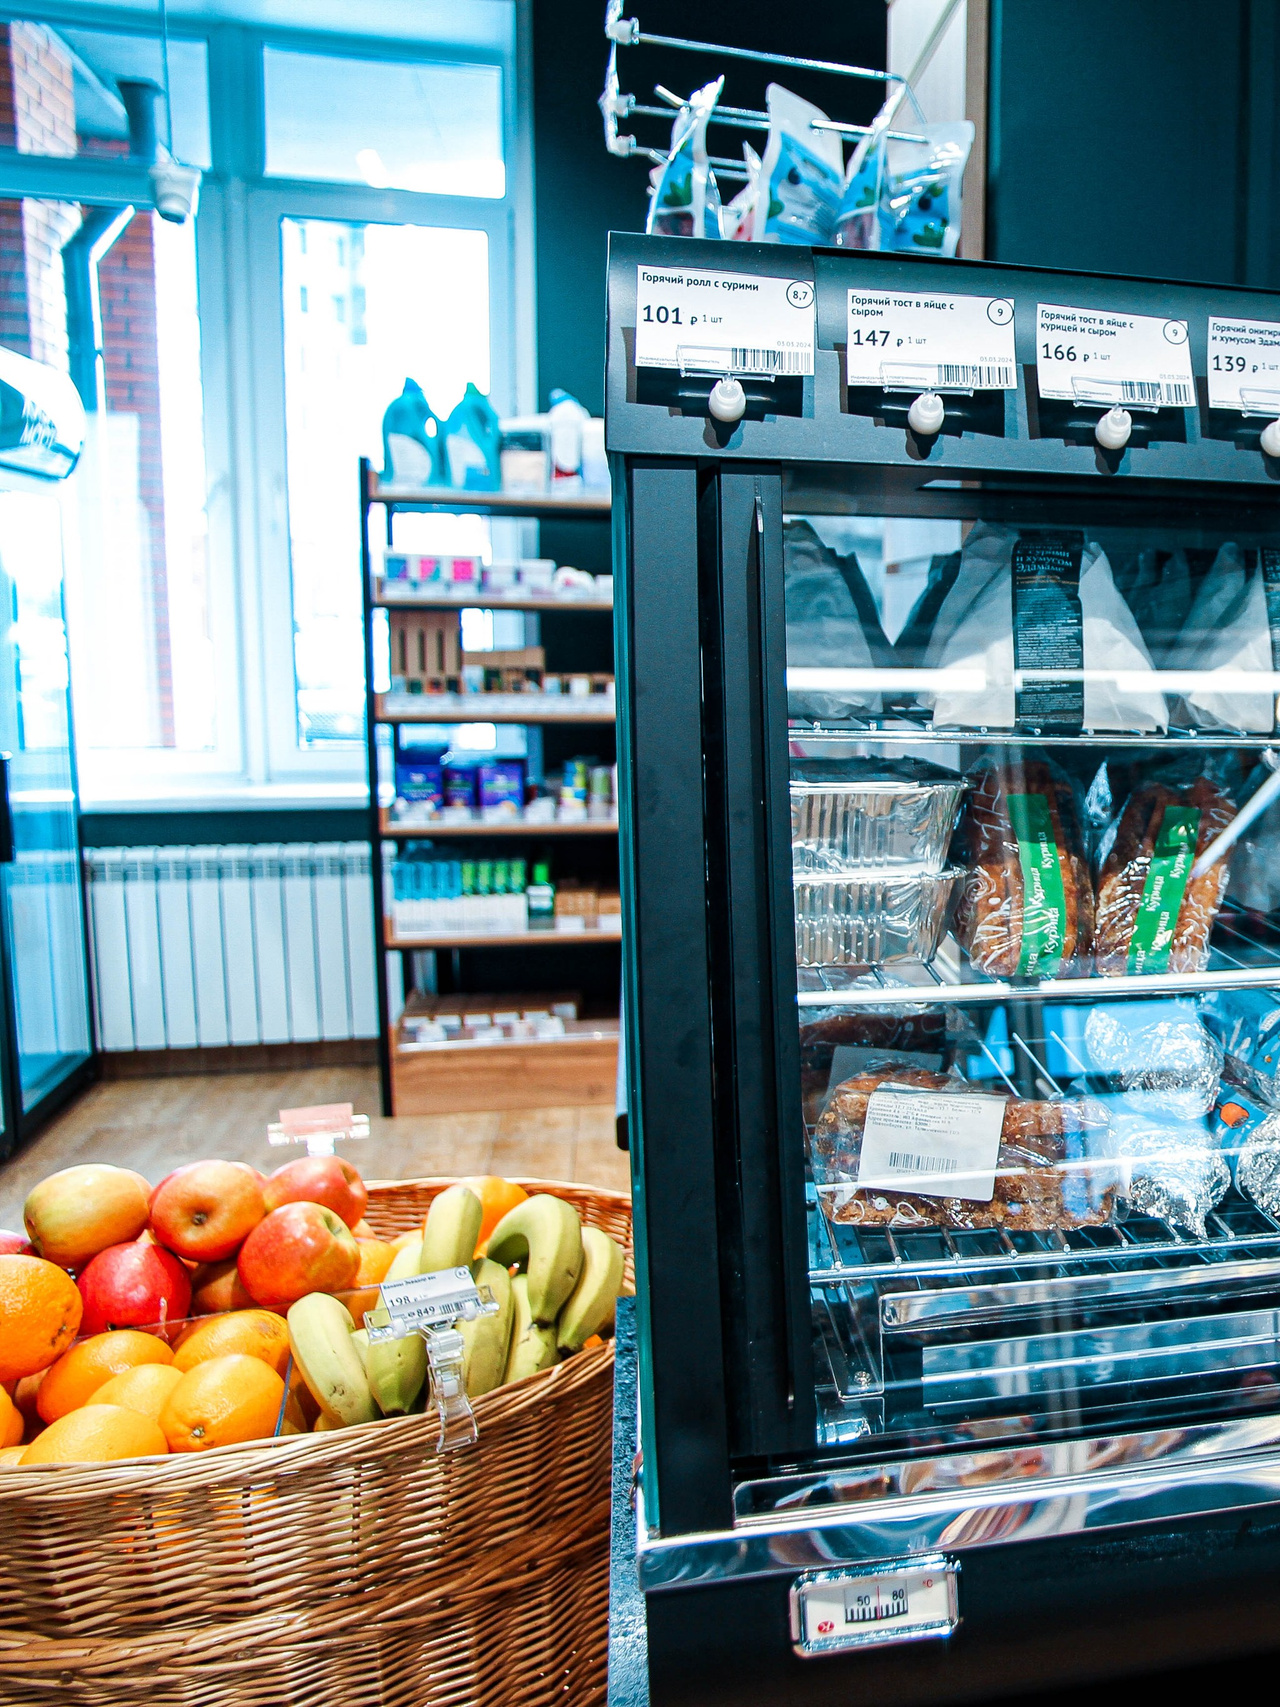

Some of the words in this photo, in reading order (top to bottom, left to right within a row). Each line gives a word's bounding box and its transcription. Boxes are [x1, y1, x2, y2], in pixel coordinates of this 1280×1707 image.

[643, 272, 683, 284] Горячий
[687, 277, 711, 288] ролл
[722, 281, 759, 291] сурими
[793, 291, 808, 300] 8,7
[852, 295, 890, 306] Горячий
[893, 300, 912, 308] тост
[924, 301, 946, 310] яйце
[642, 305, 683, 324] 101
[852, 308, 883, 317] сыром
[997, 308, 1003, 317] 9
[1041, 310, 1076, 322] Горячий
[1107, 318, 1127, 328] яйце
[1041, 322, 1077, 333] курицей
[1080, 326, 1085, 334] и
[1088, 327, 1116, 337] сыром
[1212, 323, 1246, 333] Горячий
[853, 329, 890, 346] 147
[1219, 336, 1256, 345] хумусом
[1042, 343, 1076, 361] 166
[1212, 355, 1246, 372] 139
[1038, 832, 1054, 869] Курица
[1029, 867, 1045, 908] Курица
[1146, 876, 1165, 912] Курица
[1044, 907, 1059, 954] Курица
[389, 1295, 410, 1307] 198
[416, 1306, 435, 1317] 849
[857, 1595, 870, 1607] 50
[892, 1588, 905, 1601] 80
